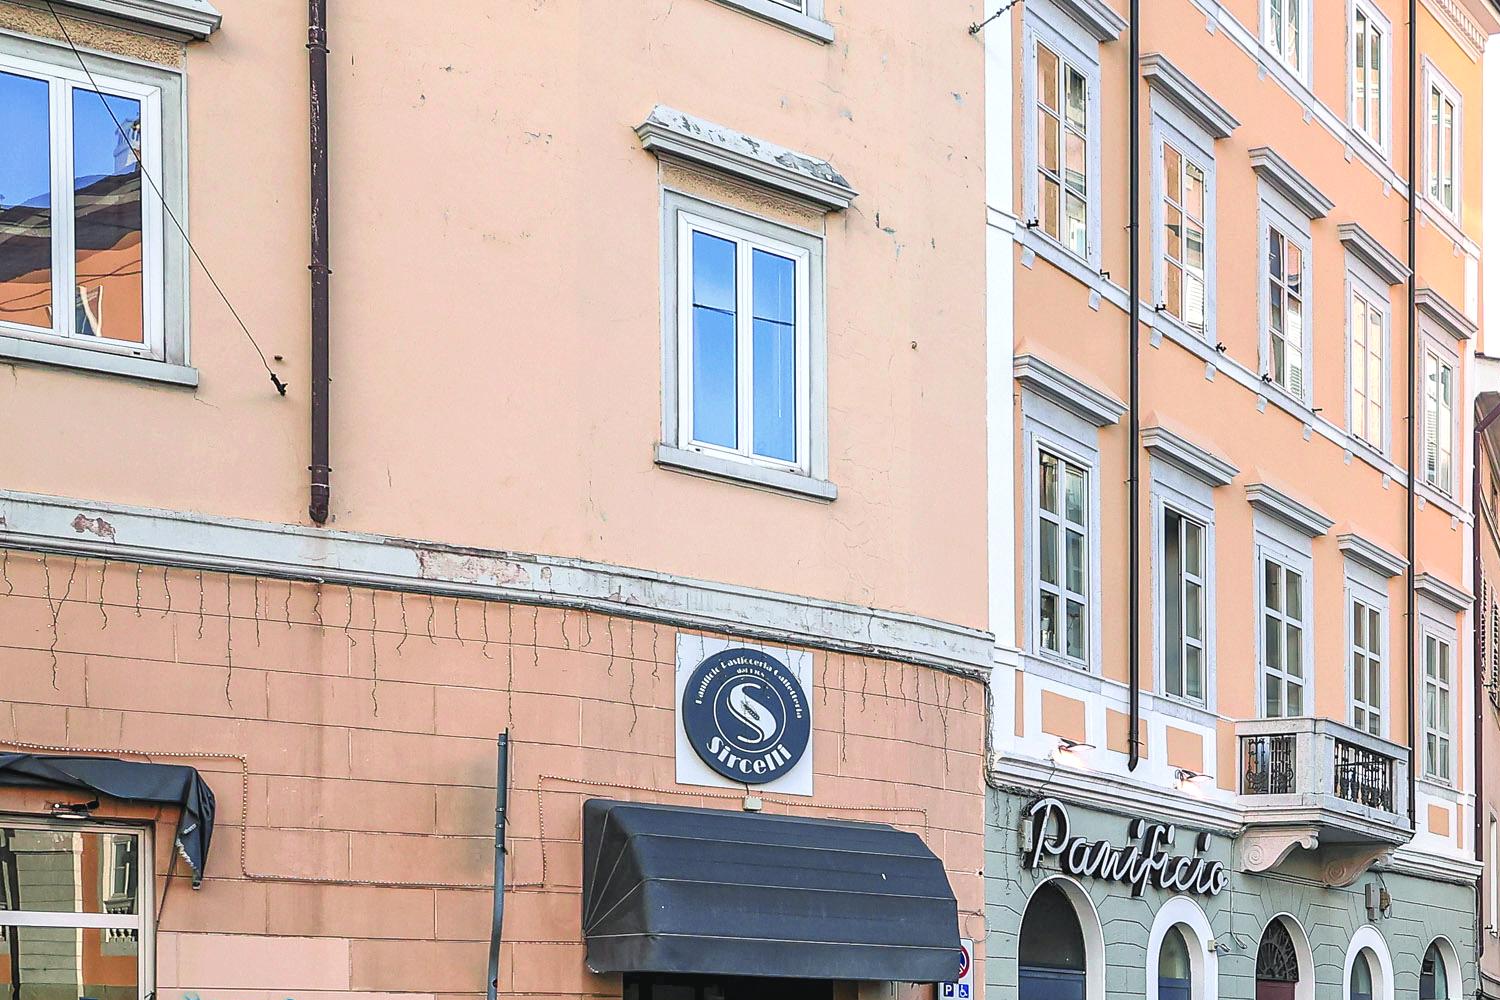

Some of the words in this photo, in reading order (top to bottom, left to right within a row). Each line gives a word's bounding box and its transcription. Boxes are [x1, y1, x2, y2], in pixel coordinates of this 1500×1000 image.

[706, 736, 792, 774] Sircelli
[1030, 797, 1229, 897] Panificio
[945, 984, 953, 995] P
